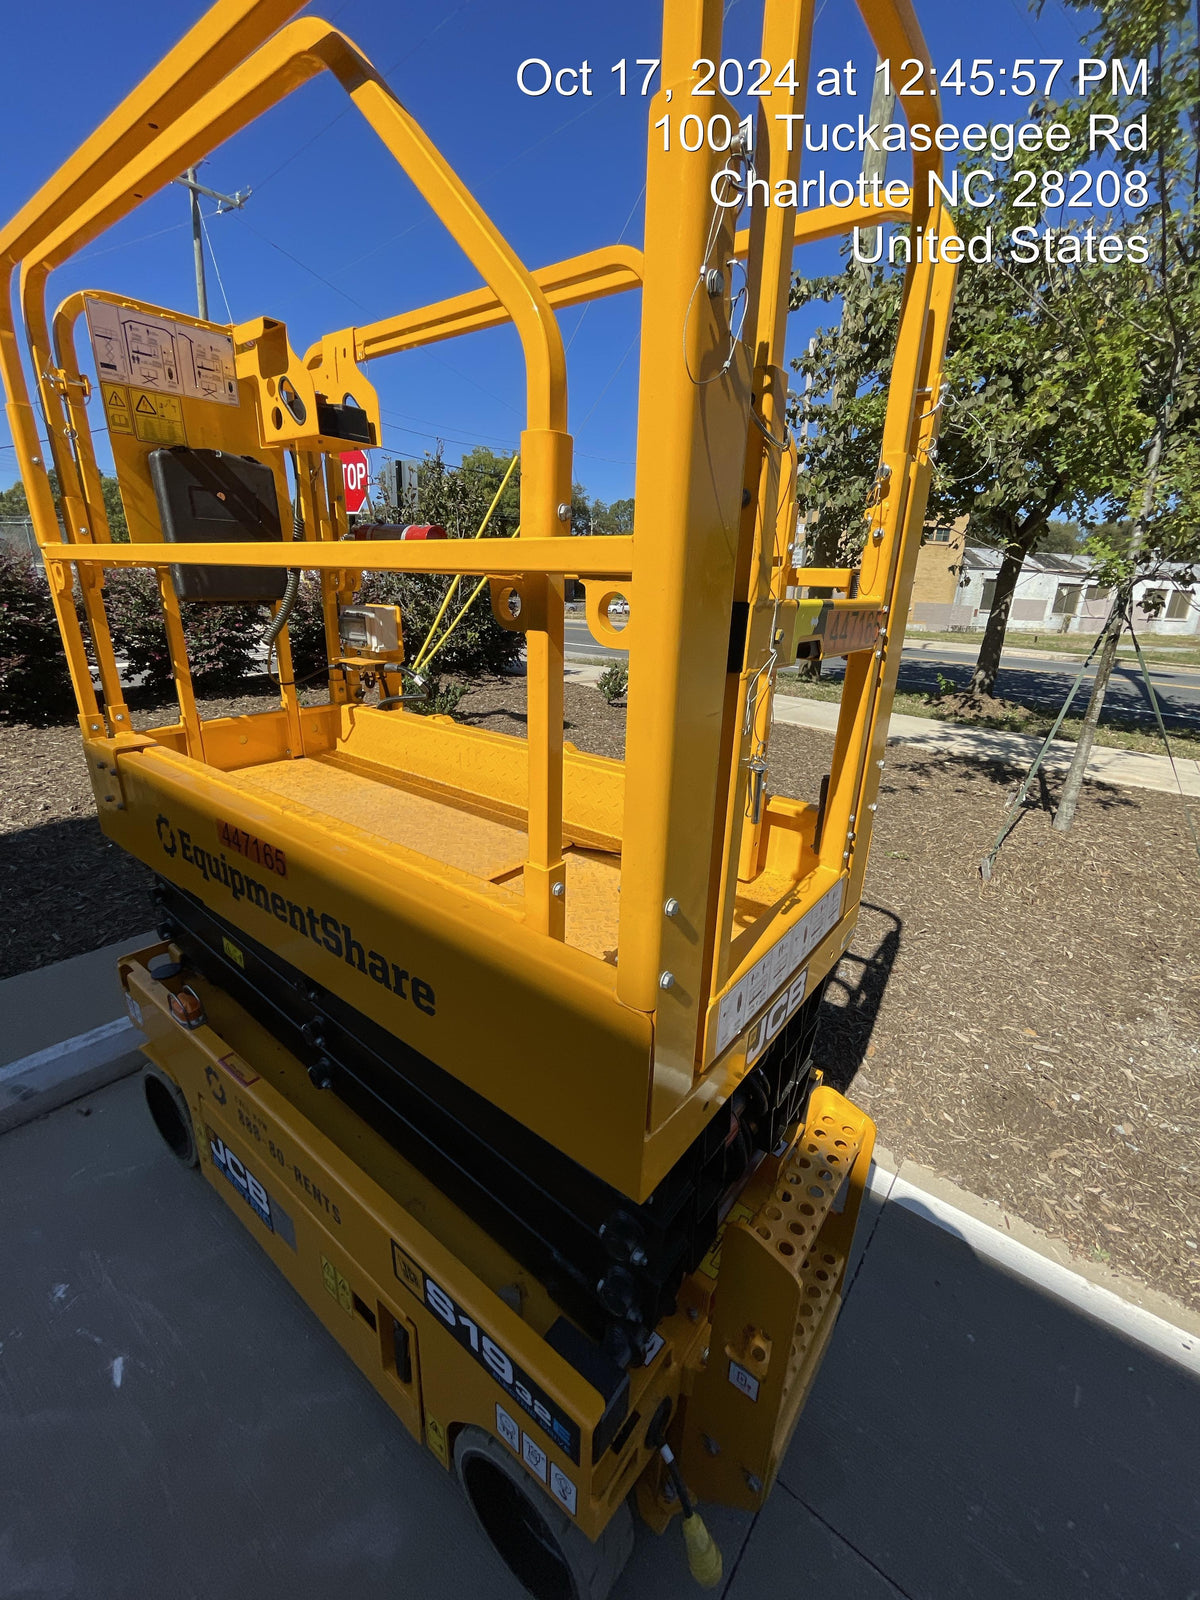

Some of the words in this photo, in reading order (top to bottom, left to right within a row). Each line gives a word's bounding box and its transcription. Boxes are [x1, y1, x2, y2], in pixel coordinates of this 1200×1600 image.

[342, 462, 366, 490] TOP
[221, 821, 287, 877] 447165
[177, 828, 436, 1017] EquipmentShare
[746, 970, 808, 1065] JCB
[210, 1137, 270, 1216] JCB
